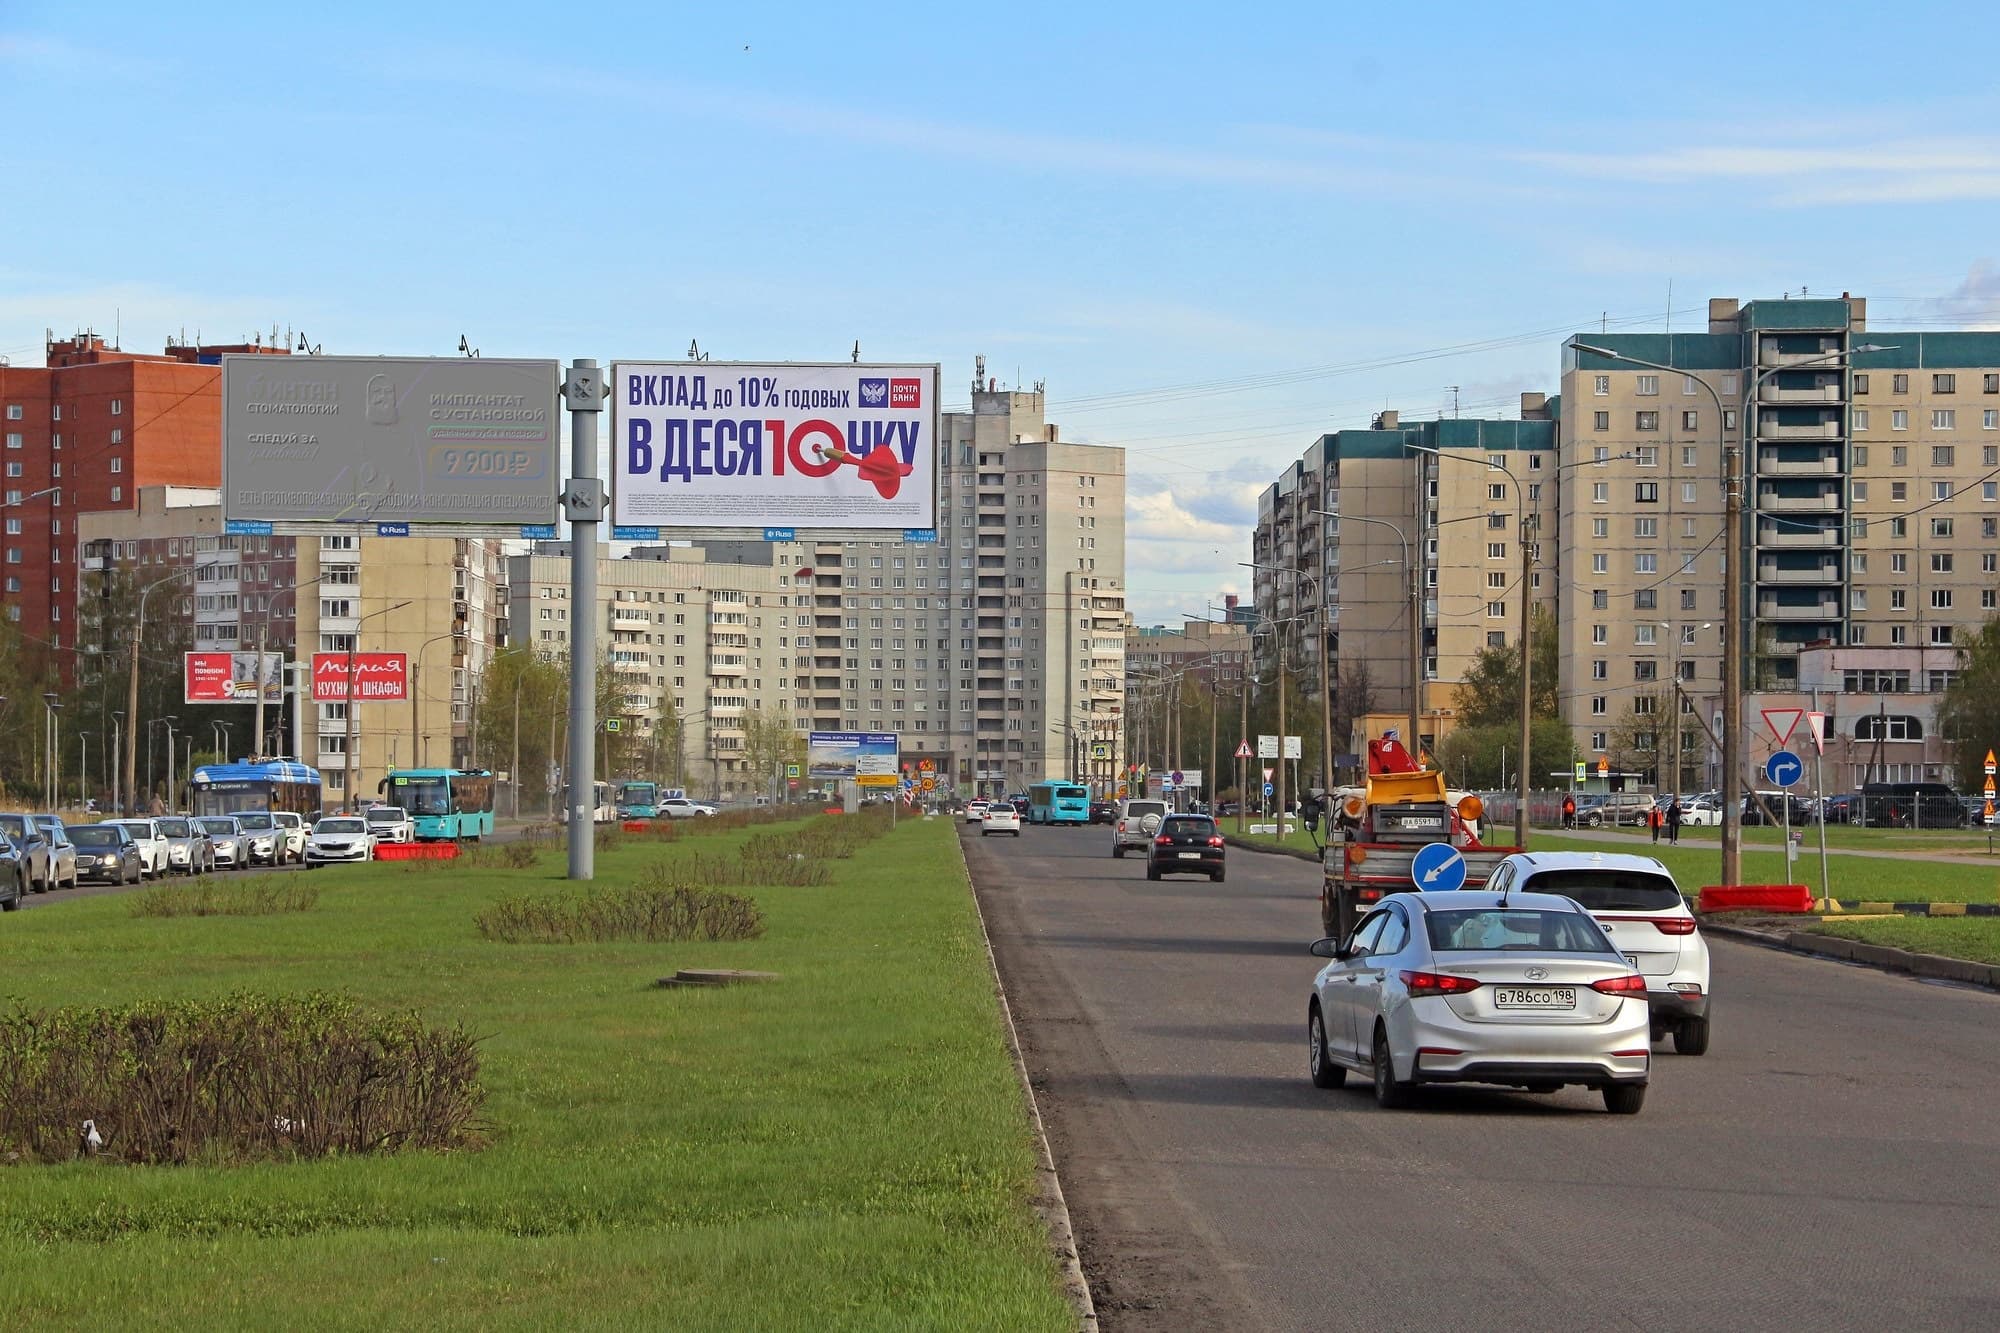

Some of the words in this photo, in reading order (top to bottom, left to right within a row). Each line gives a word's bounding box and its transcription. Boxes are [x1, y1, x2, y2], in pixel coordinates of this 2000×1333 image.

[628, 374, 707, 410] ВКЛАД
[738, 376, 780, 408] 10%
[784, 388, 850, 410] ГОДОВЫХ
[892, 384, 918, 393] ПОЧТА
[430, 393, 525, 407] ИМПЛАНТАТ
[892, 393, 915, 402] БАНК
[246, 402, 339, 415] СТОМАТОЛОГИИ
[430, 408, 441, 420] С
[443, 407, 545, 421] УСТАНОВКОЙ
[247, 432, 298, 445] СЛЕДУЙ
[301, 433, 319, 445] ЗА
[628, 418, 653, 475] В
[388, 526, 406, 535] Russ
[775, 530, 792, 538] Russ
[317, 660, 402, 682] Мария
[222, 679, 235, 697] 9
[317, 681, 349, 696] КУХНИ
[362, 680, 402, 696] ШКАФЫ
[1499, 990, 1551, 1003] В786СО
[1552, 990, 1572, 1000] 198
